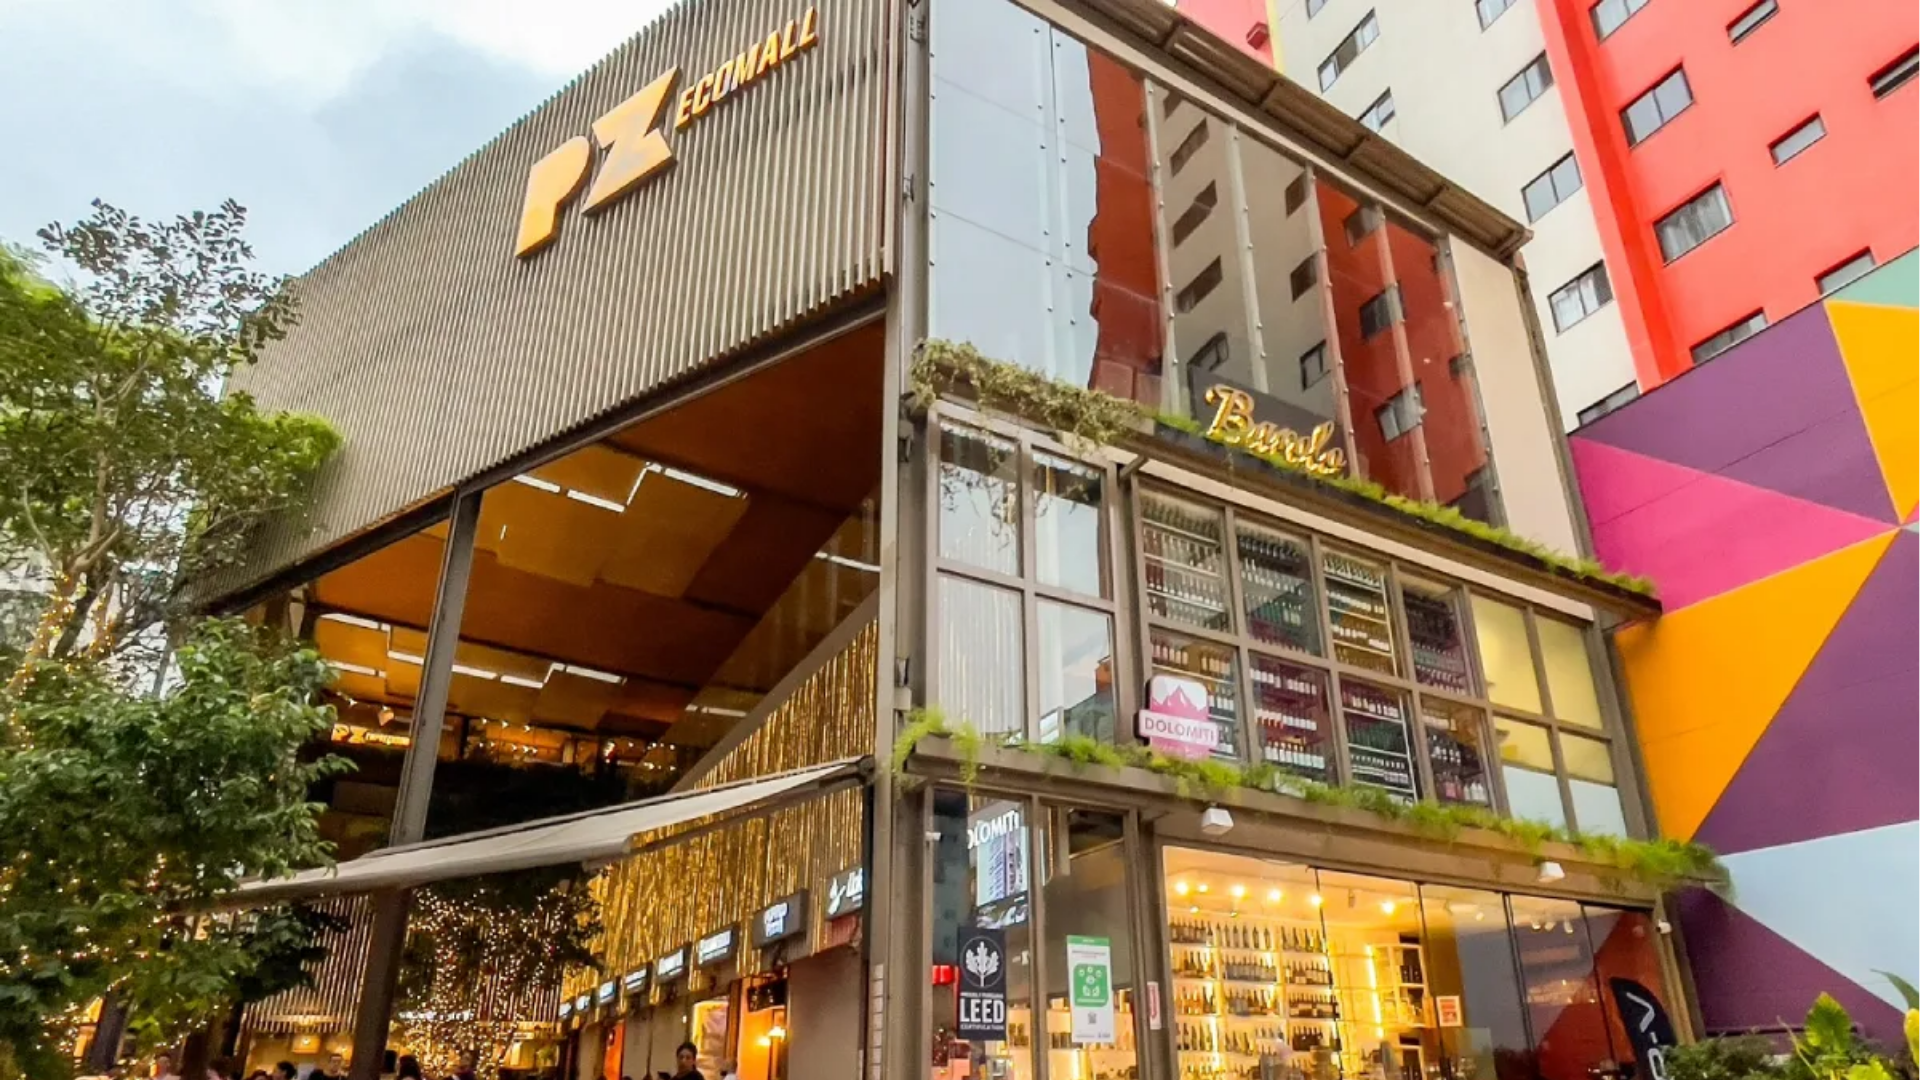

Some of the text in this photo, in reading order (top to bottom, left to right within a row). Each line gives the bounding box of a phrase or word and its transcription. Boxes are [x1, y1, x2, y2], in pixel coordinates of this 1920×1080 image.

[515, 6, 818, 259] PZ ECOMALL
[1144, 717, 1215, 742] DOLOMITI
[959, 999, 1005, 1024] LEED
